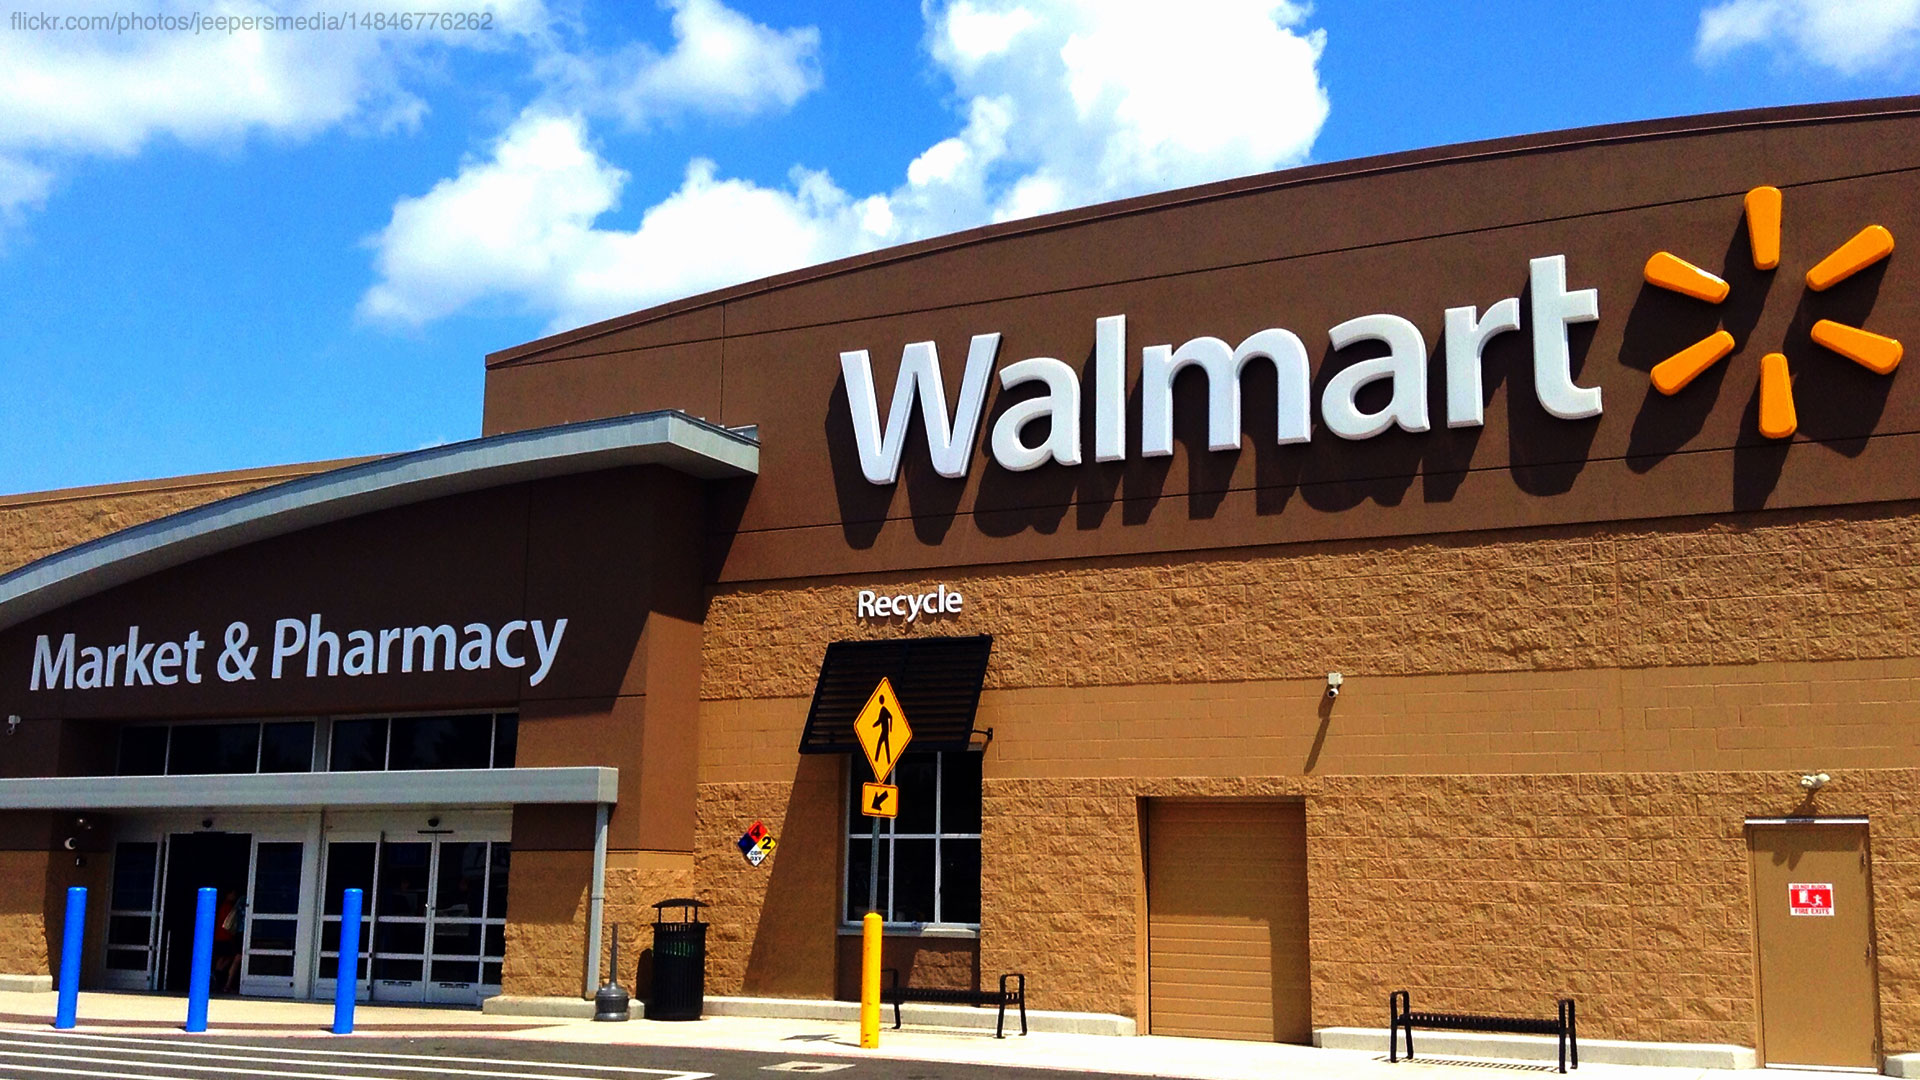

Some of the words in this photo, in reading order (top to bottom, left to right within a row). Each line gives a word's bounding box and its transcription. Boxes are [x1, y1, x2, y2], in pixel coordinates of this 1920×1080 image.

[840, 254, 1602, 485] Walmart
[857, 584, 963, 622] Recycle
[30, 626, 204, 691] Market
[217, 621, 256, 682] &
[271, 613, 568, 686] Pharmacy
[751, 825, 761, 838] 4
[761, 836, 772, 849] 2
